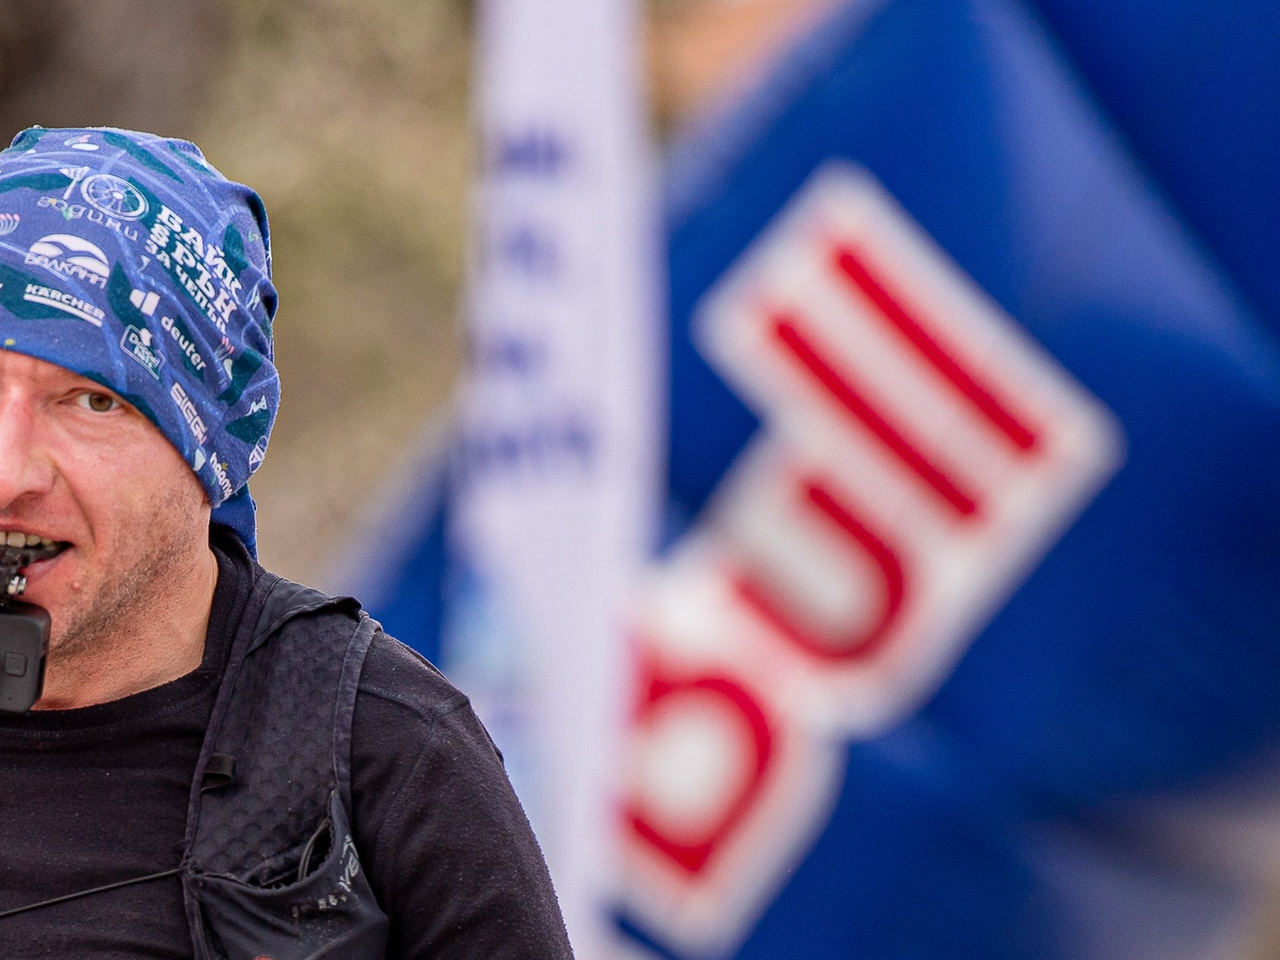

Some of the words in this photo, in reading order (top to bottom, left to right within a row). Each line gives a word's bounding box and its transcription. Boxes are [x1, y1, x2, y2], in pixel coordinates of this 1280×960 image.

[144, 239, 171, 269] ЗА
[156, 204, 242, 303] БАЙК
[171, 241, 238, 323] РЪН
[161, 316, 207, 371] deuter
